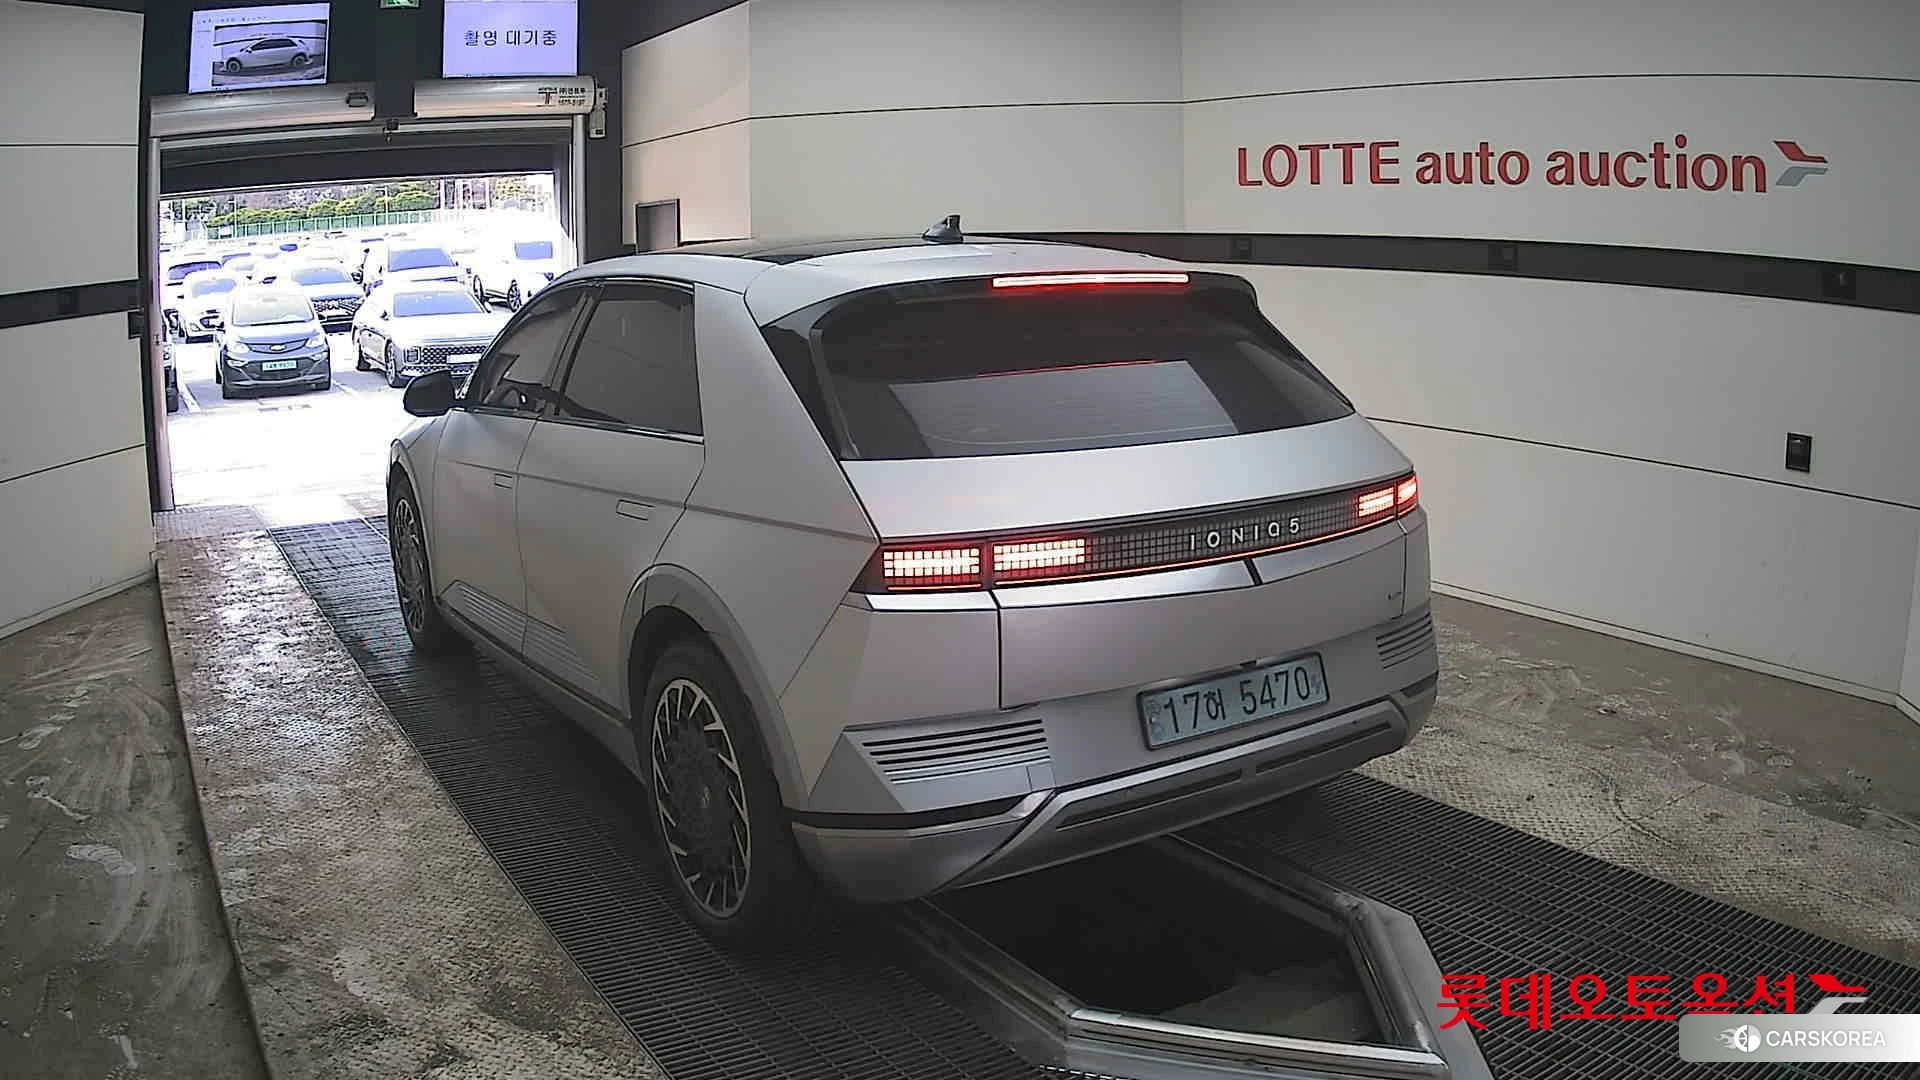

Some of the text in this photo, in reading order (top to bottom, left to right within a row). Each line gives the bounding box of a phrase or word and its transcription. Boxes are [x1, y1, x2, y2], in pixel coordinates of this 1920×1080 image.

[464, 30, 557, 47] 촬영 대기중
[1237, 134, 1767, 193] LOTTE auto auction
[1163, 666, 1310, 734] 17허 5470
